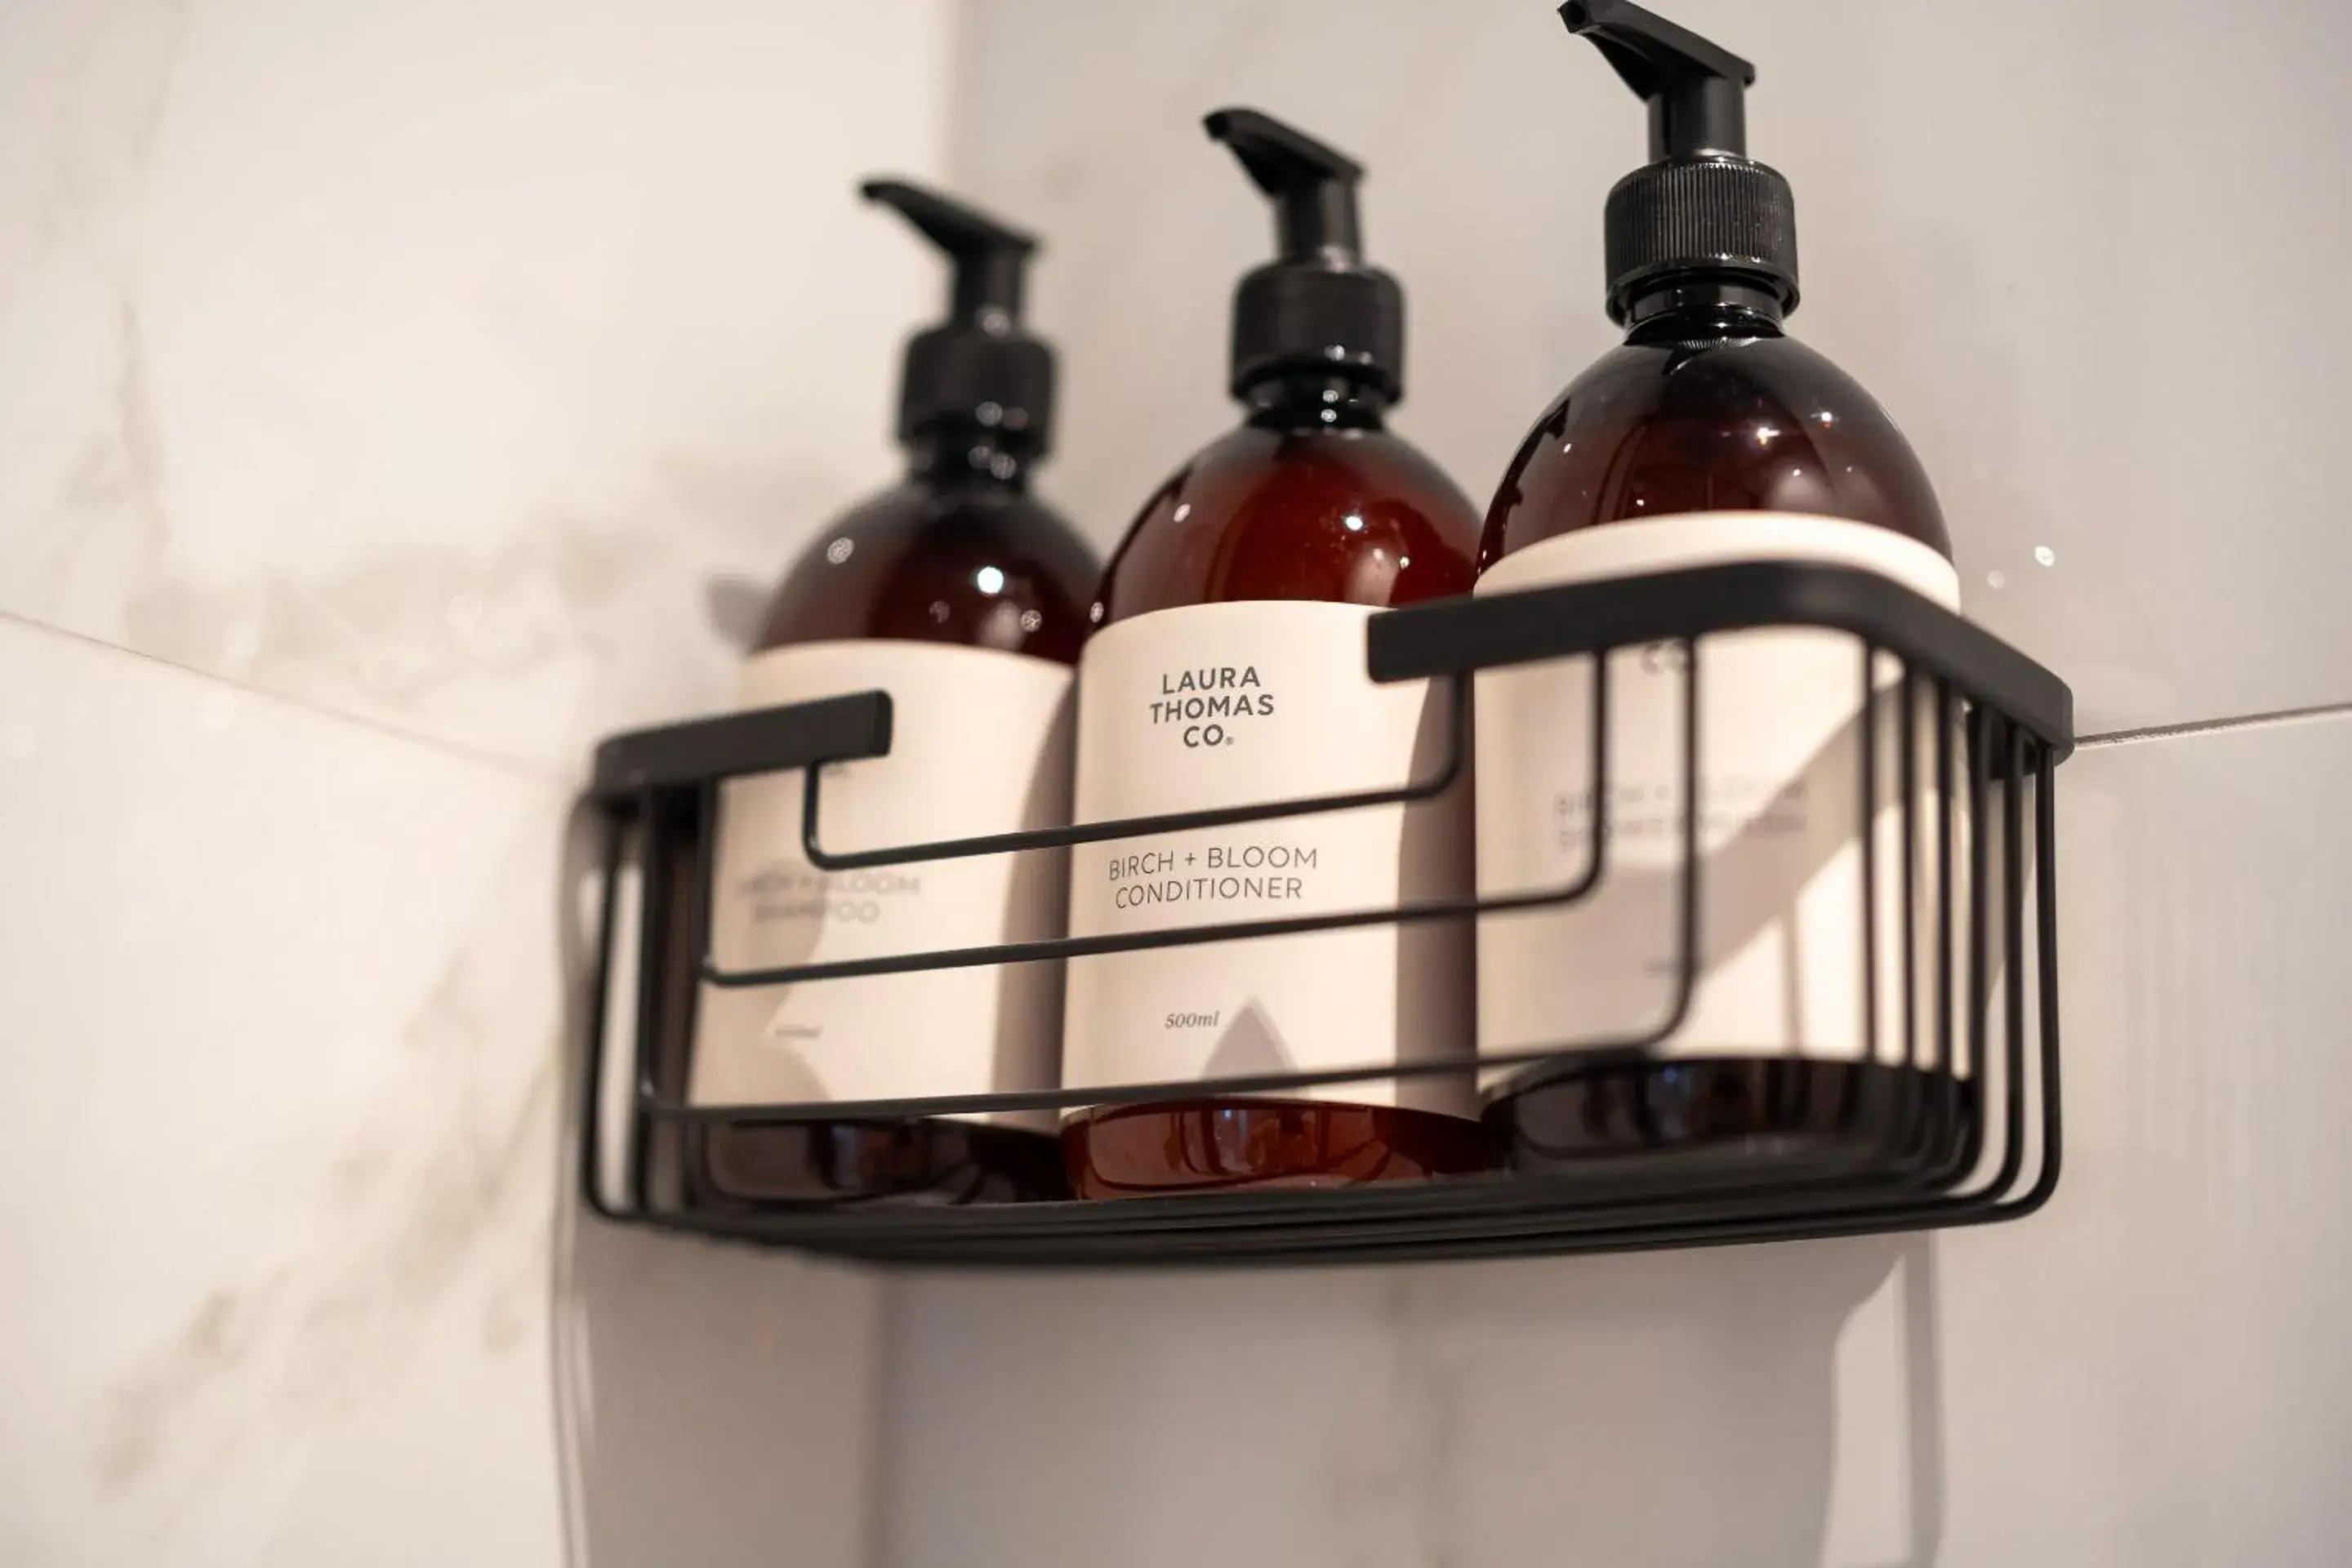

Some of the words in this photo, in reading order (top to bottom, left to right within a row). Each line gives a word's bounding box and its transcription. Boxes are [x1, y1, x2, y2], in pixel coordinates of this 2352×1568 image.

[1162, 666, 1261, 694] LAURA
[1149, 693, 1275, 724] THOMAS
[1108, 849, 1174, 881] BIRCH
[1184, 852, 1197, 866] +
[1207, 845, 1317, 870] BLOOM
[1115, 876, 1303, 910] CONDITIONER
[1164, 1010, 1220, 1030] 500ml
